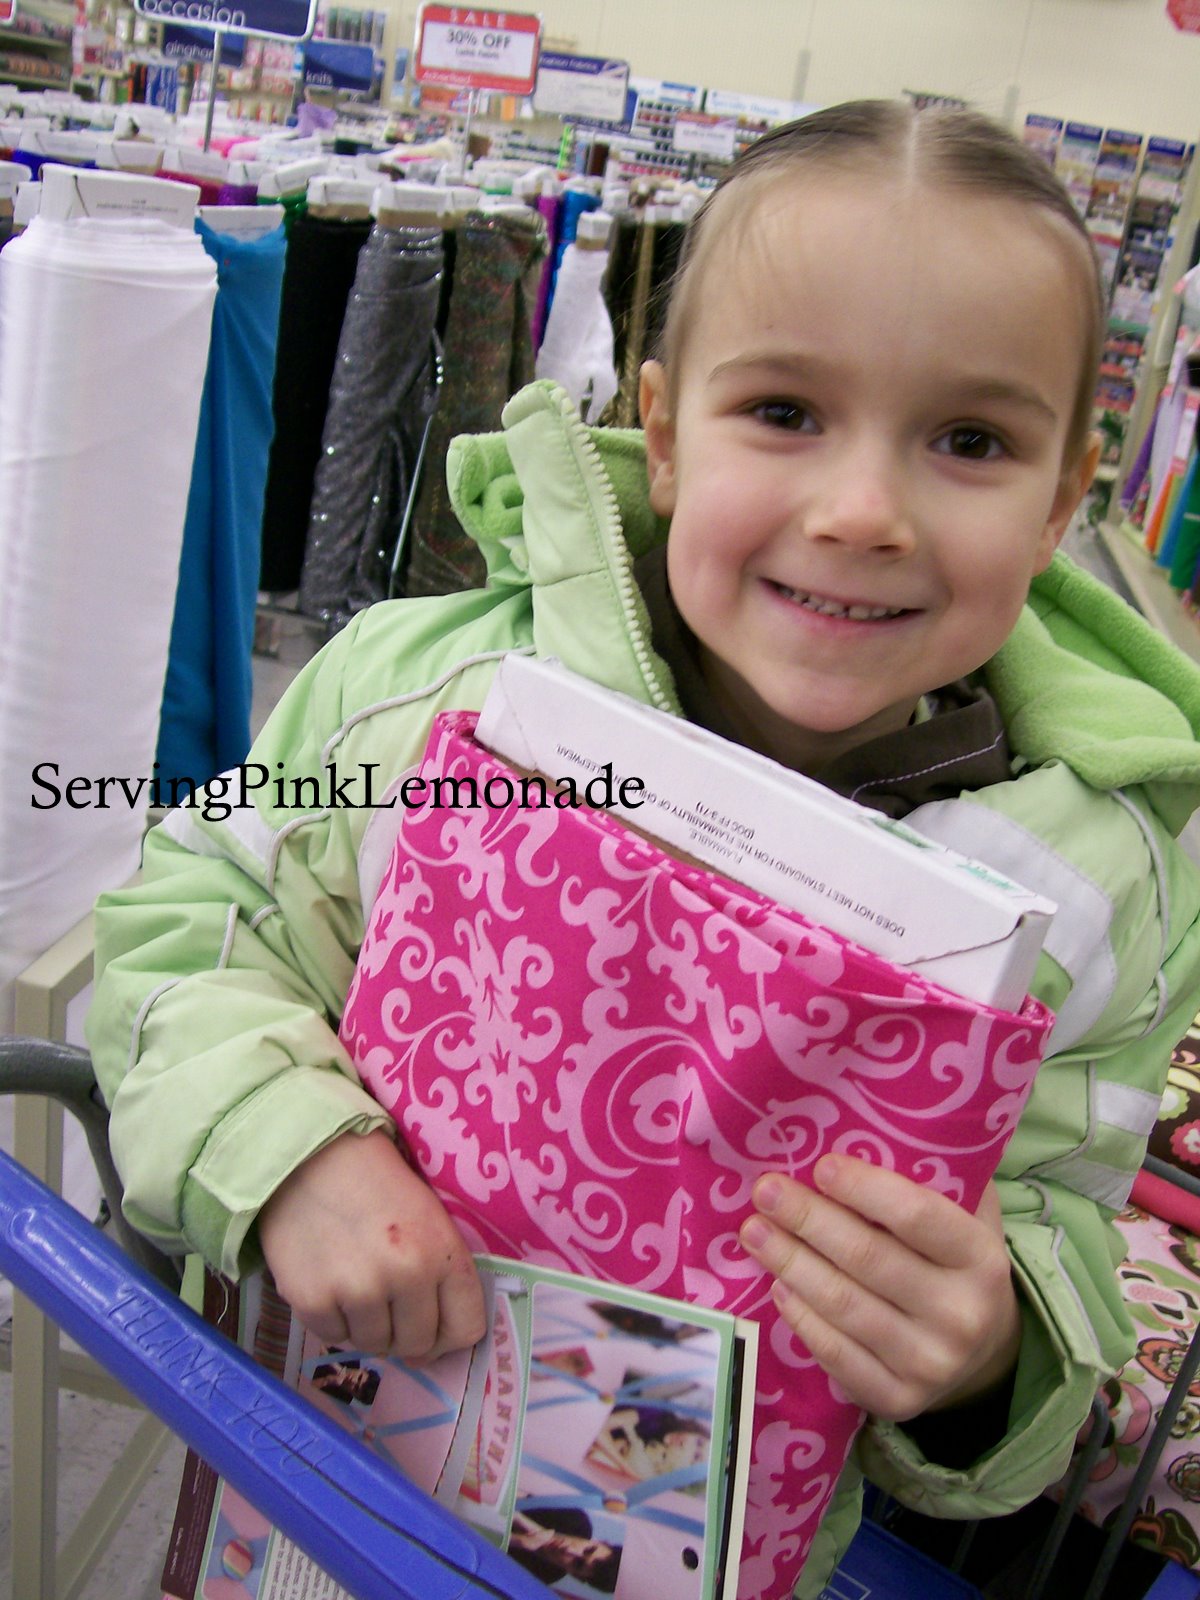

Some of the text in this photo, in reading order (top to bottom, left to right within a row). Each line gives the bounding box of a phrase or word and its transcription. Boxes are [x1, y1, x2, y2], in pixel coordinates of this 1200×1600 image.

[144, 0, 245, 27] occasion
[450, 8, 506, 30] SALE
[447, 28, 511, 48] 30% OFF
[658, 798, 672, 810] OF
[670, 804, 736, 844] FLAMMABILITY
[734, 839, 753, 855] THE
[752, 848, 775, 866] FOR
[773, 859, 826, 893] STANDARD
[825, 887, 854, 908] MEET
[852, 901, 876, 920] NOT
[874, 913, 906, 937] DOES
